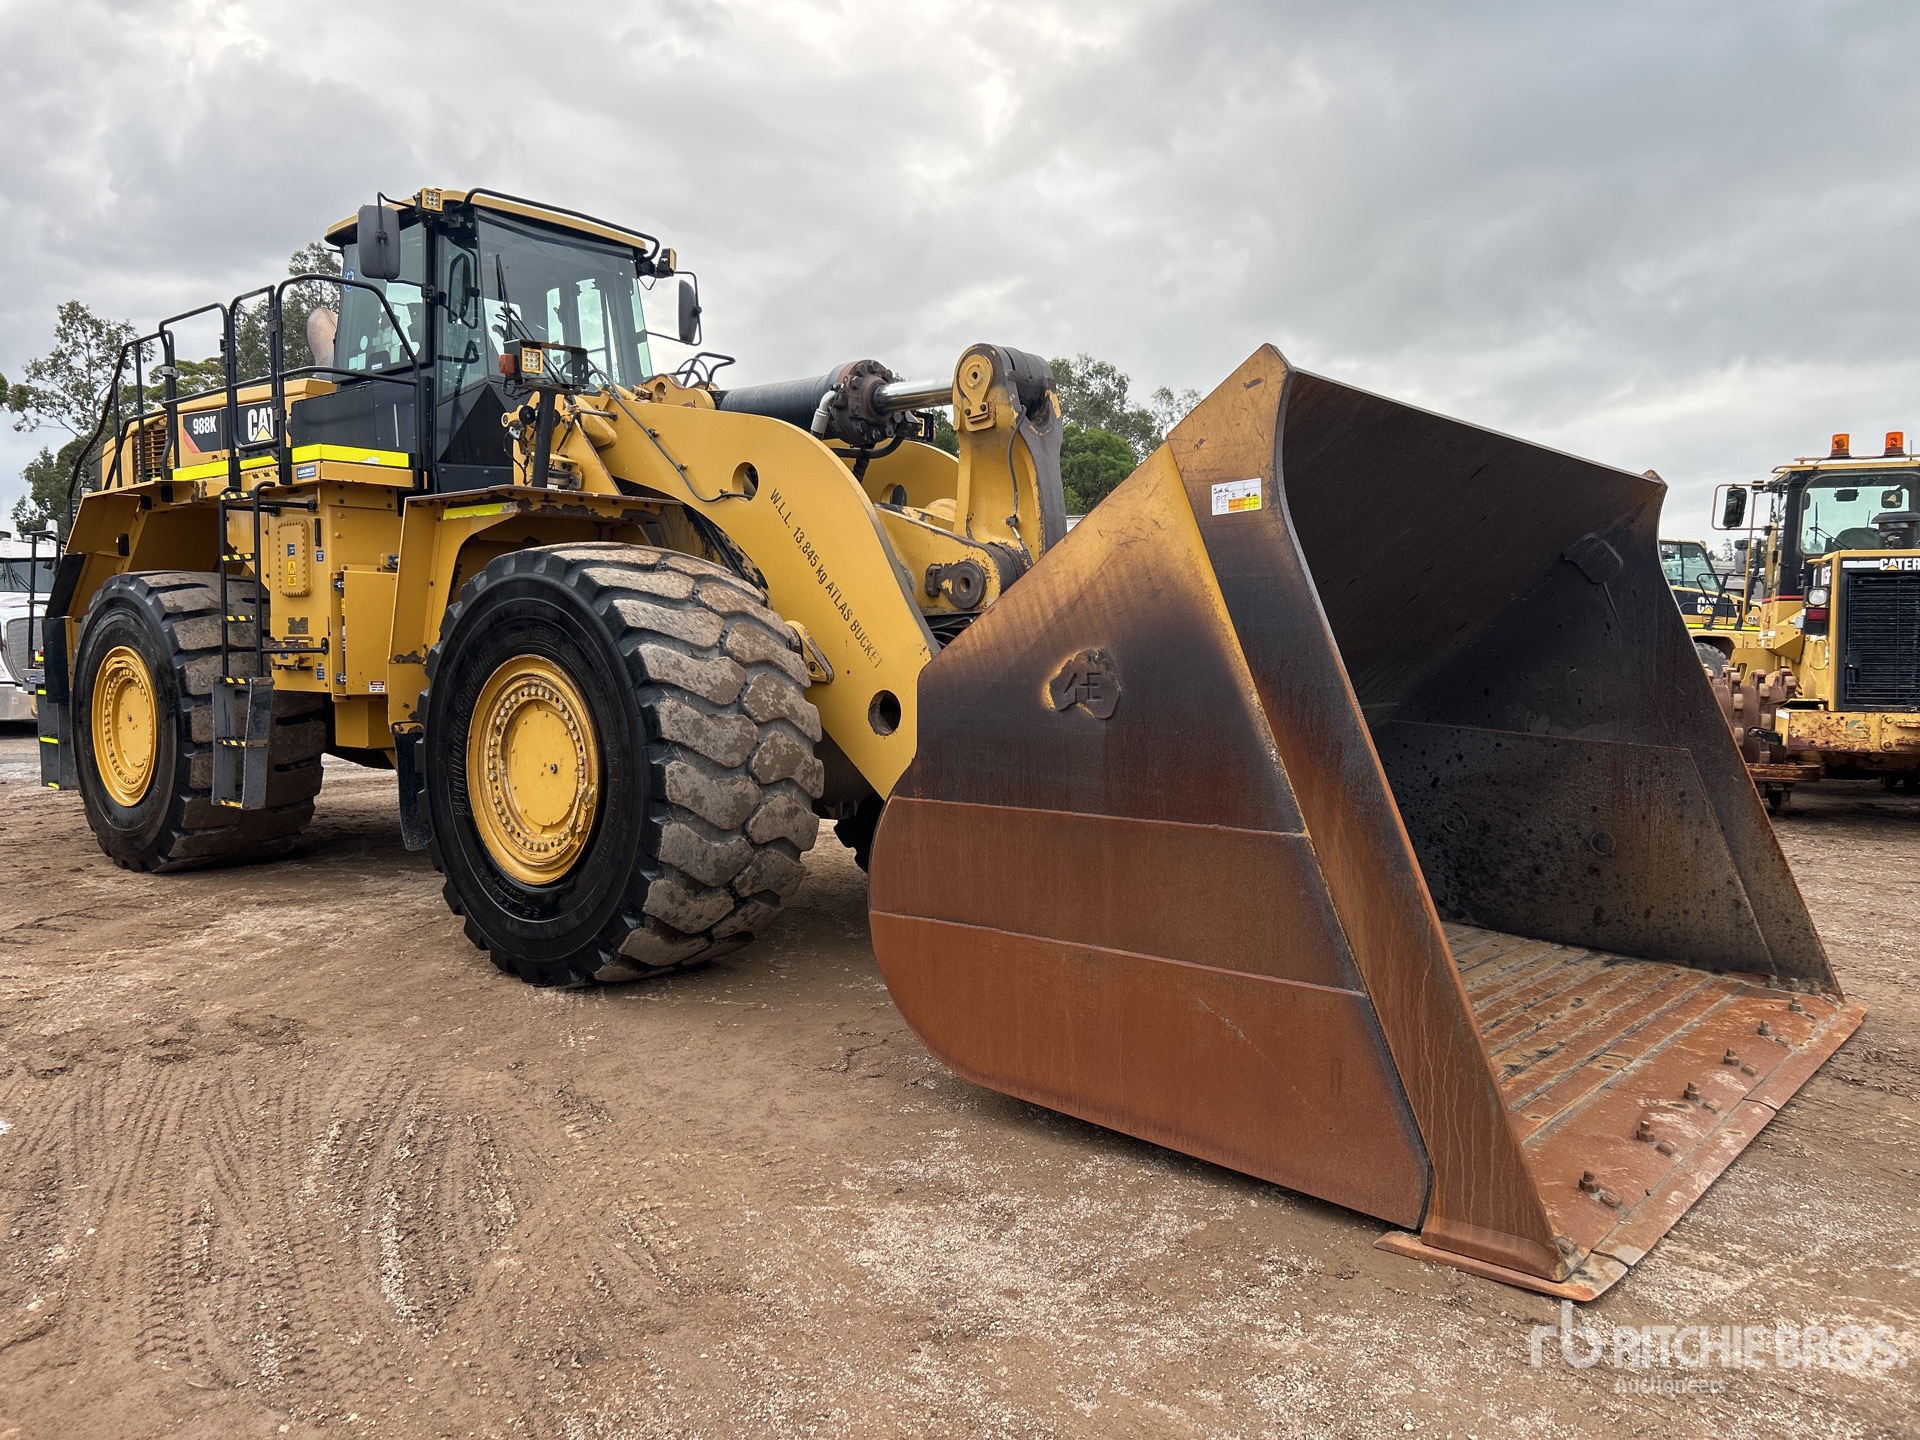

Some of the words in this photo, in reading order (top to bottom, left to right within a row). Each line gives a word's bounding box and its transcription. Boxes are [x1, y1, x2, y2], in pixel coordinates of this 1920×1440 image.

[192, 415, 217, 435] 988K
[770, 488, 792, 528] W.L.L.
[793, 526, 820, 567] 13,845
[815, 564, 828, 585] kg
[825, 581, 853, 622] ATLAS
[850, 619, 883, 668] BUCKET
